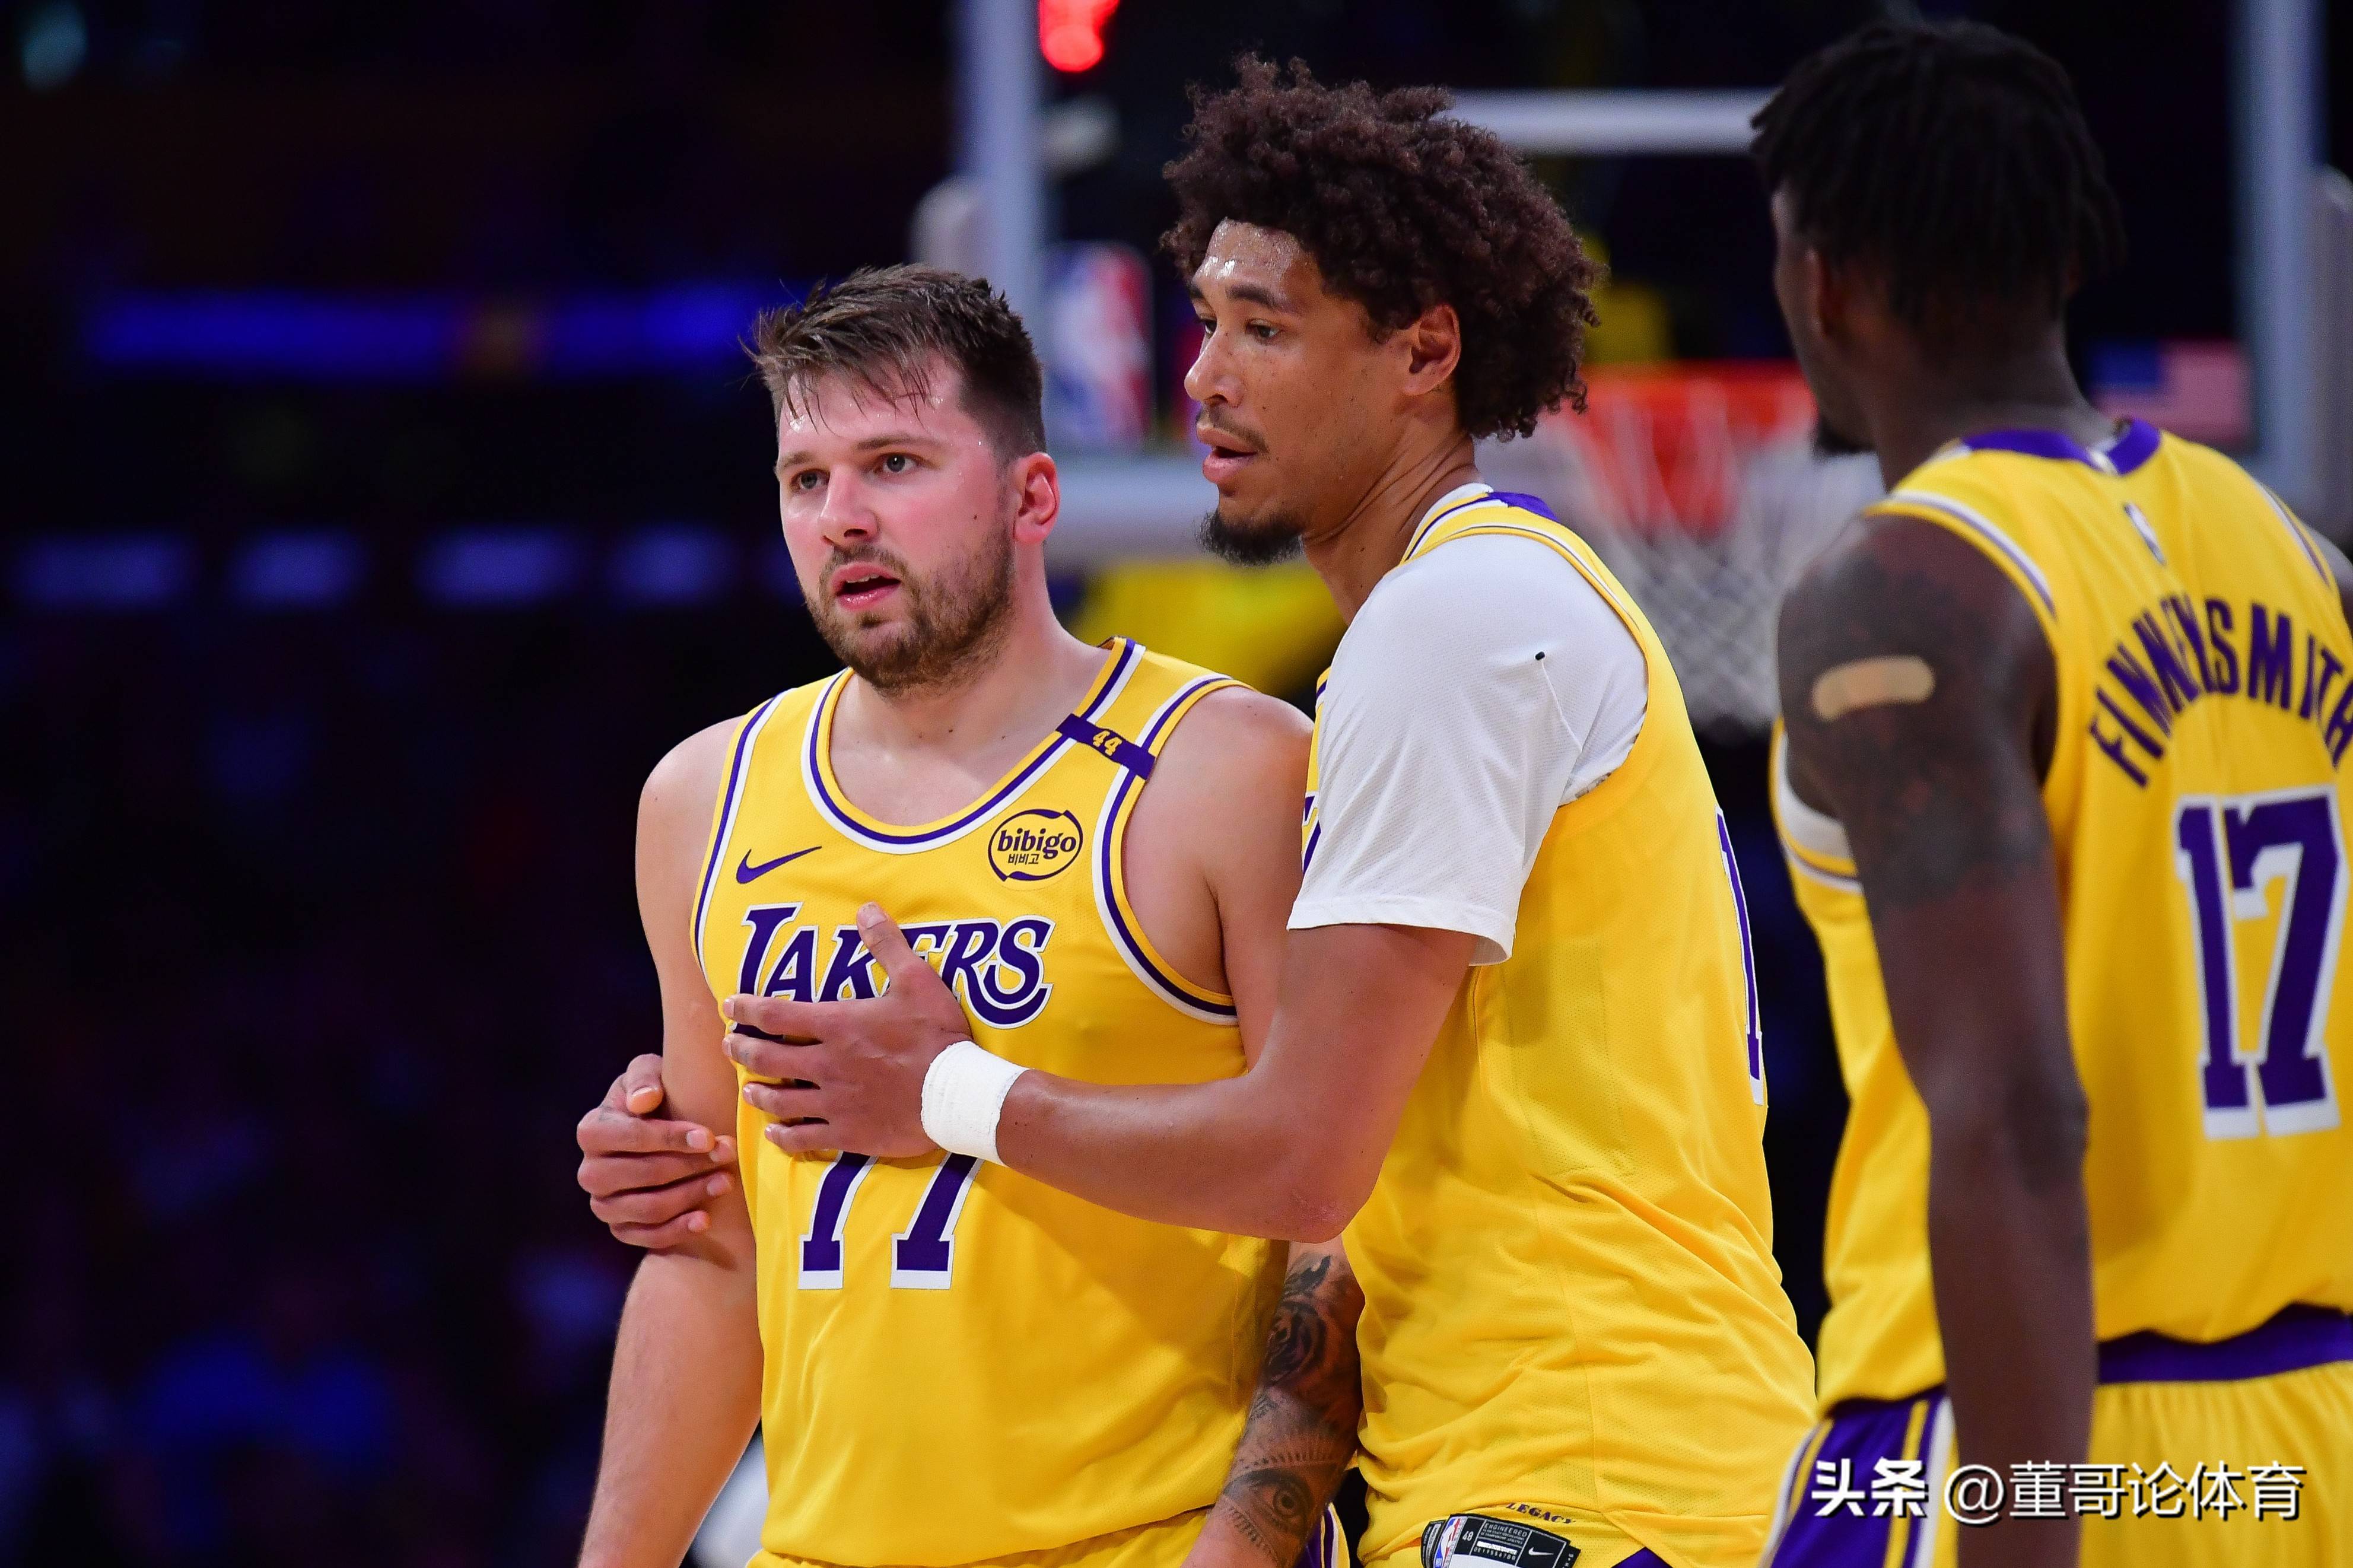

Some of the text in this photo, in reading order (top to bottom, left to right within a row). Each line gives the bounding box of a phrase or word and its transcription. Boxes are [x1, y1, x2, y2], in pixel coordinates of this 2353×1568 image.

[1092, 730, 1123, 756] 44
[997, 828, 1077, 860] bibigo
[1007, 853, 1039, 866] 비비고
[2175, 783, 2350, 1140] 17
[797, 1151, 987, 1290] 77
